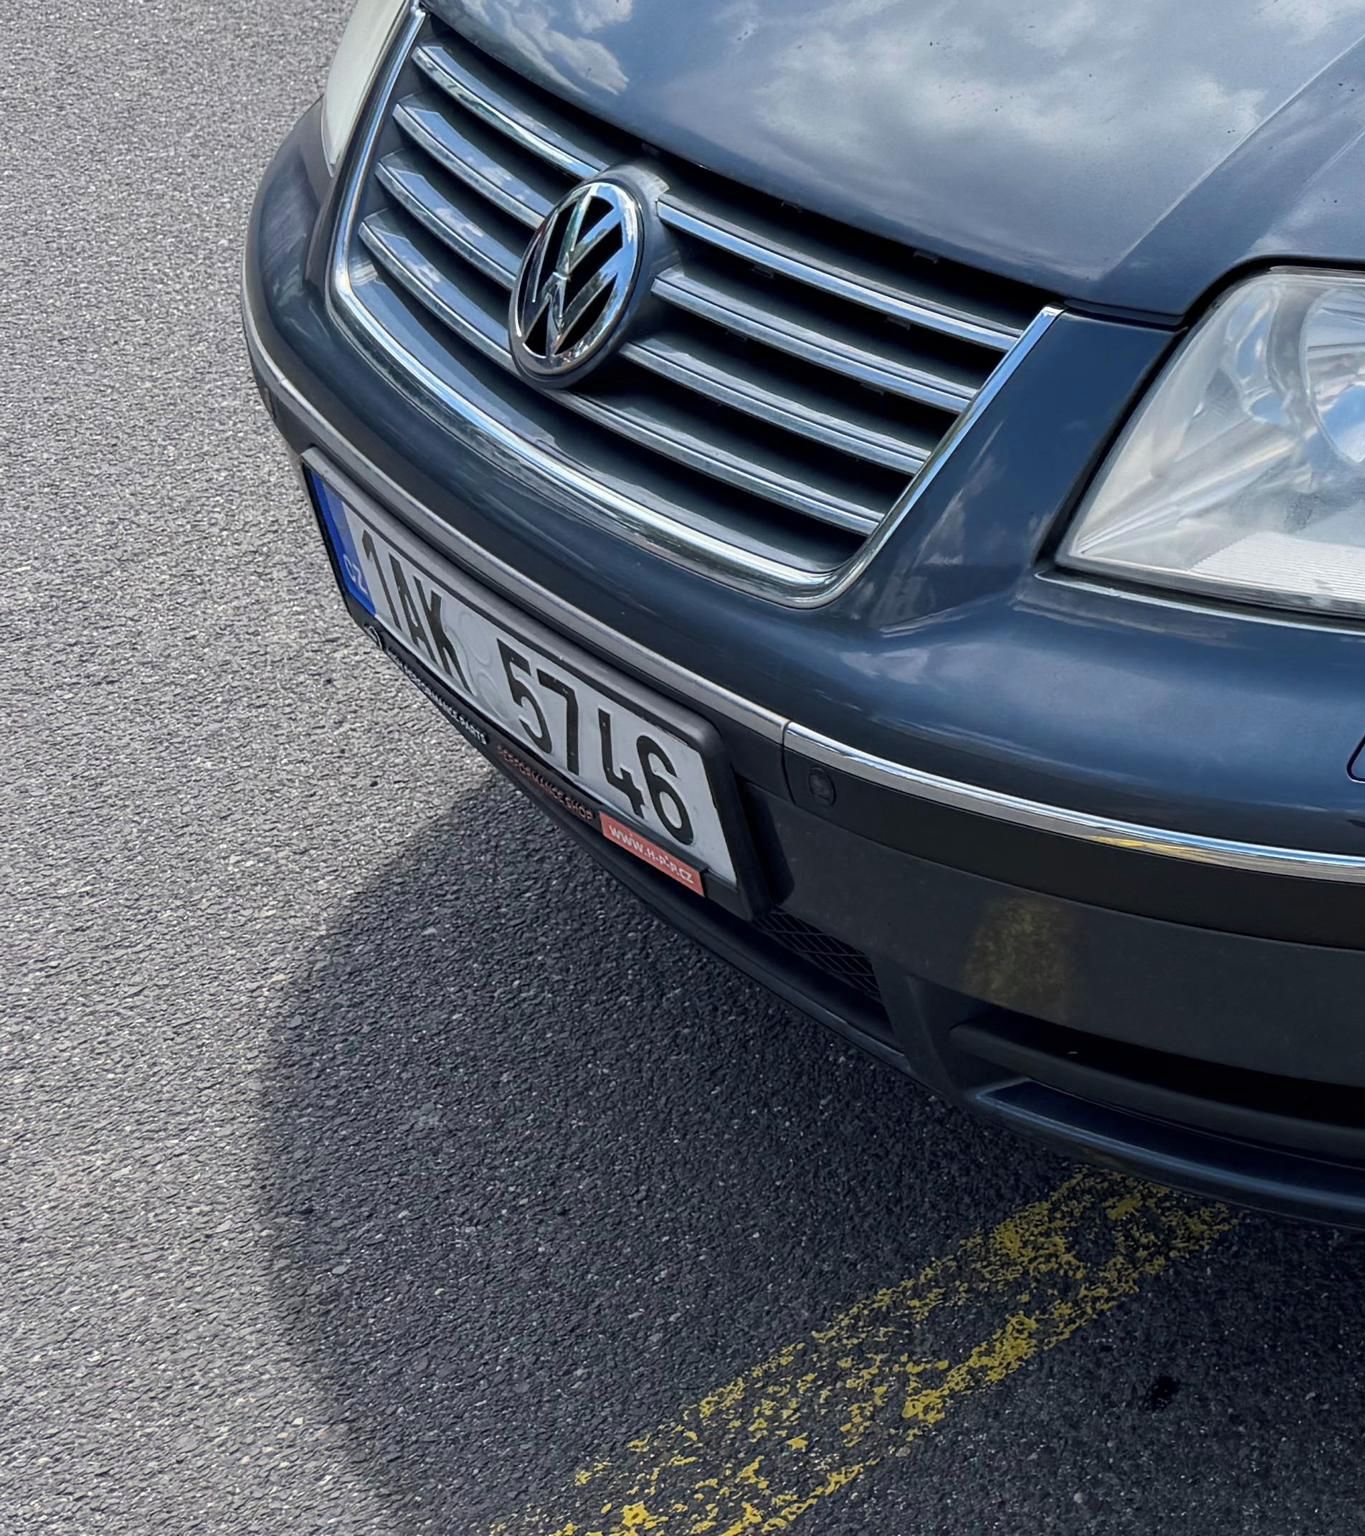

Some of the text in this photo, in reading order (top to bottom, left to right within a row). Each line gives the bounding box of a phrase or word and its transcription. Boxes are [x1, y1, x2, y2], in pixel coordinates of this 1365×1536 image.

[343, 553, 369, 596] CZ
[362, 529, 695, 846] 1AK 5746
[565, 795, 595, 822] SHOP
